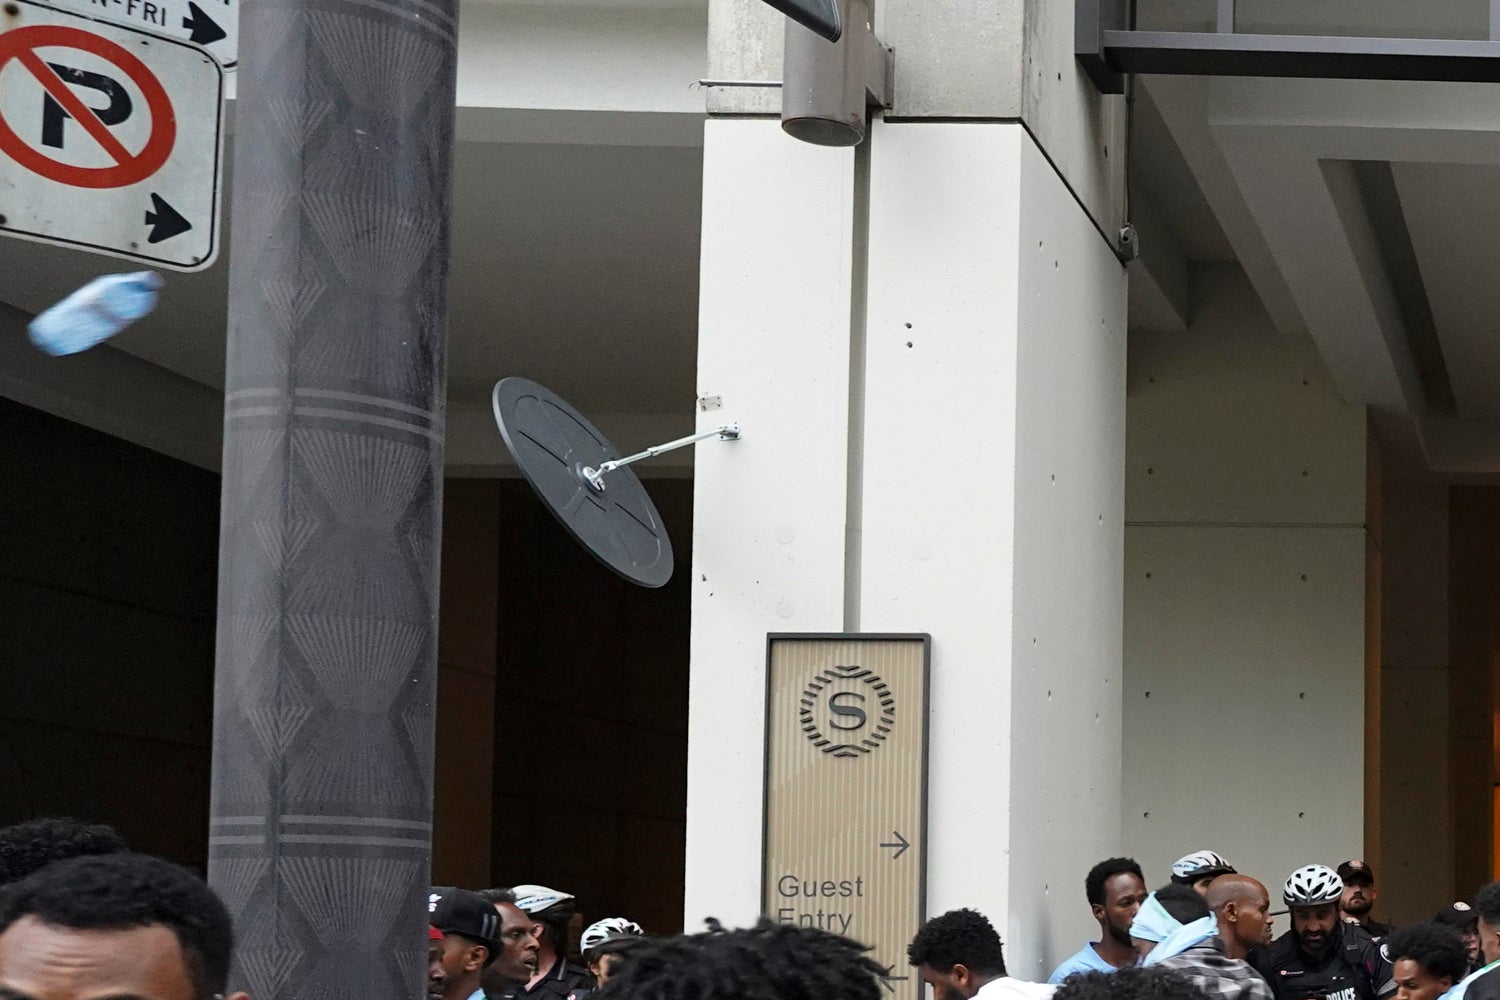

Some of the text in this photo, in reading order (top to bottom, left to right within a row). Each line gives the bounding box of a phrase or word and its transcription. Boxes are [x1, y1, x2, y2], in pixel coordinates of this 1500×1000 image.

[828, 691, 867, 731] S
[778, 875, 863, 897] Guest
[778, 908, 852, 935] Entry
